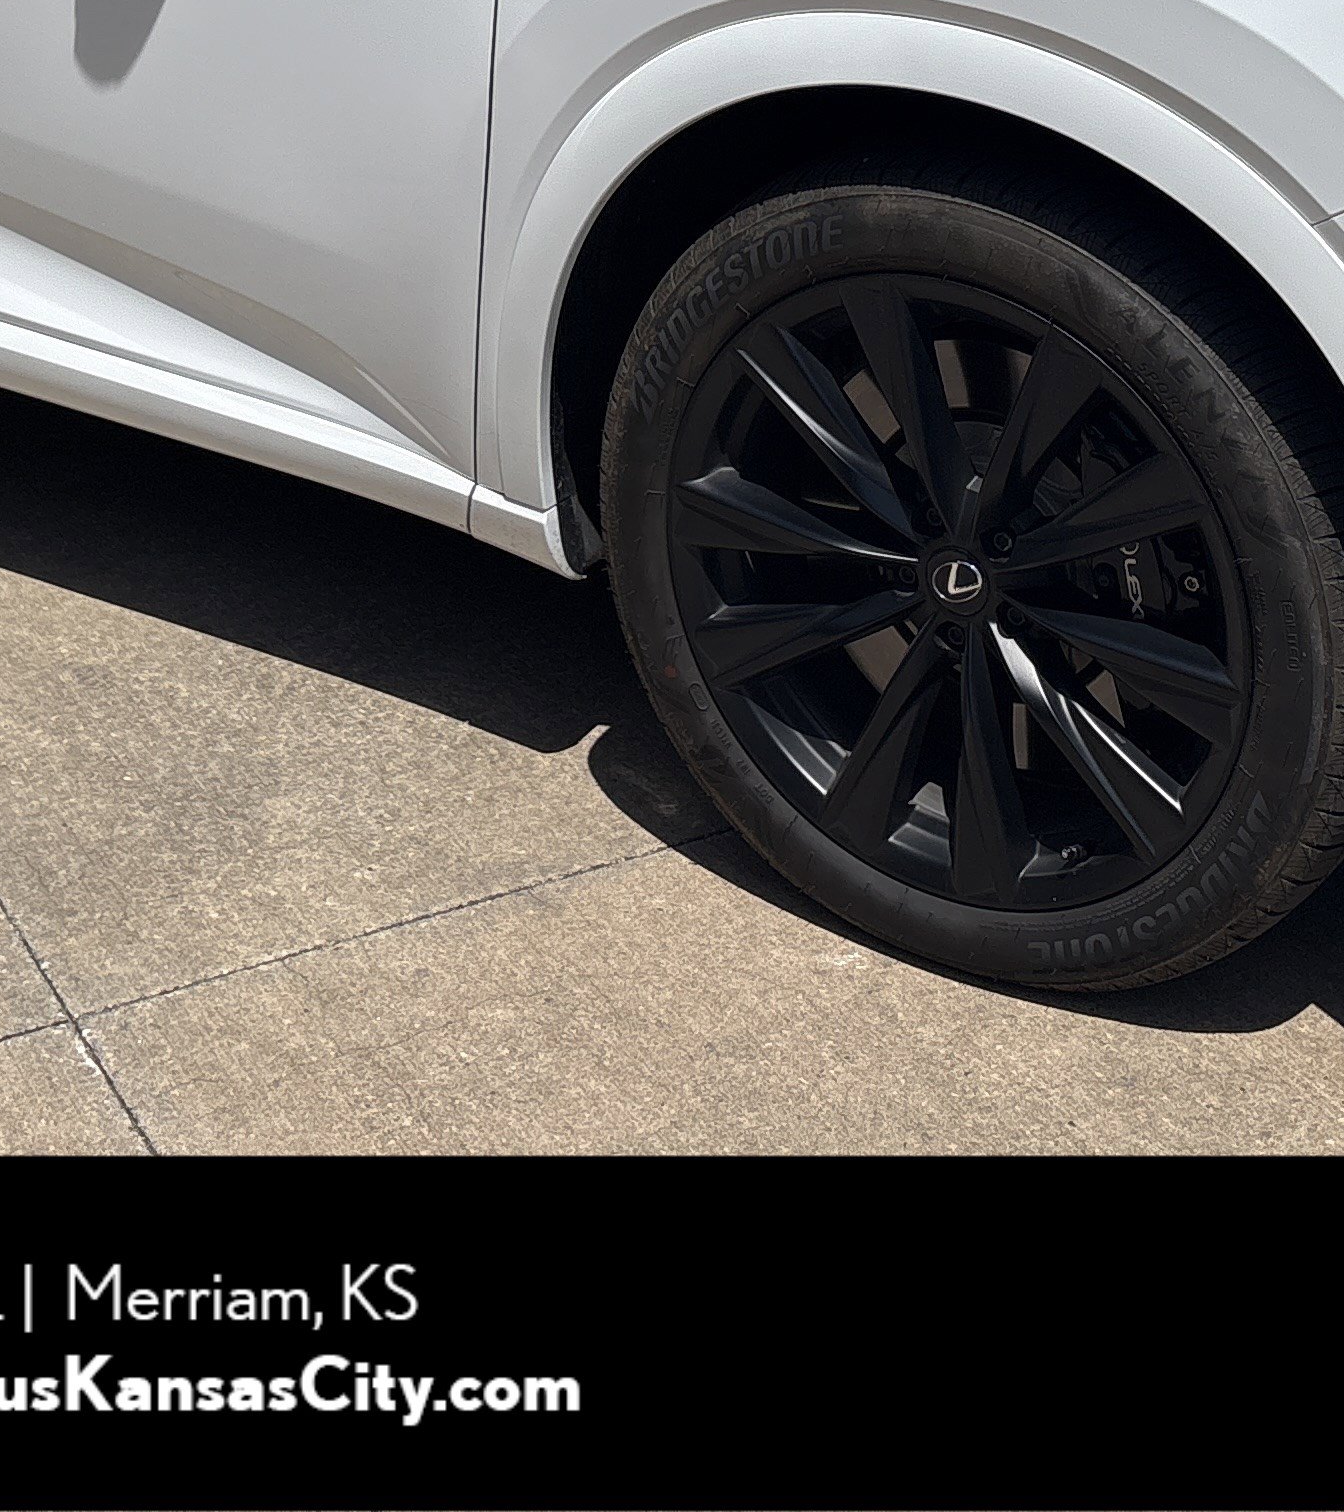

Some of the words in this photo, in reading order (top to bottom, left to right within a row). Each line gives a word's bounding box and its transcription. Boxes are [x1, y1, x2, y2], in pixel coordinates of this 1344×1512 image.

[630, 214, 846, 424] BRIDGESTONE
[1137, 360, 1193, 420] SPORT
[1123, 559, 1145, 619] LEX
[1026, 789, 1275, 965] BRIDGESTONE
